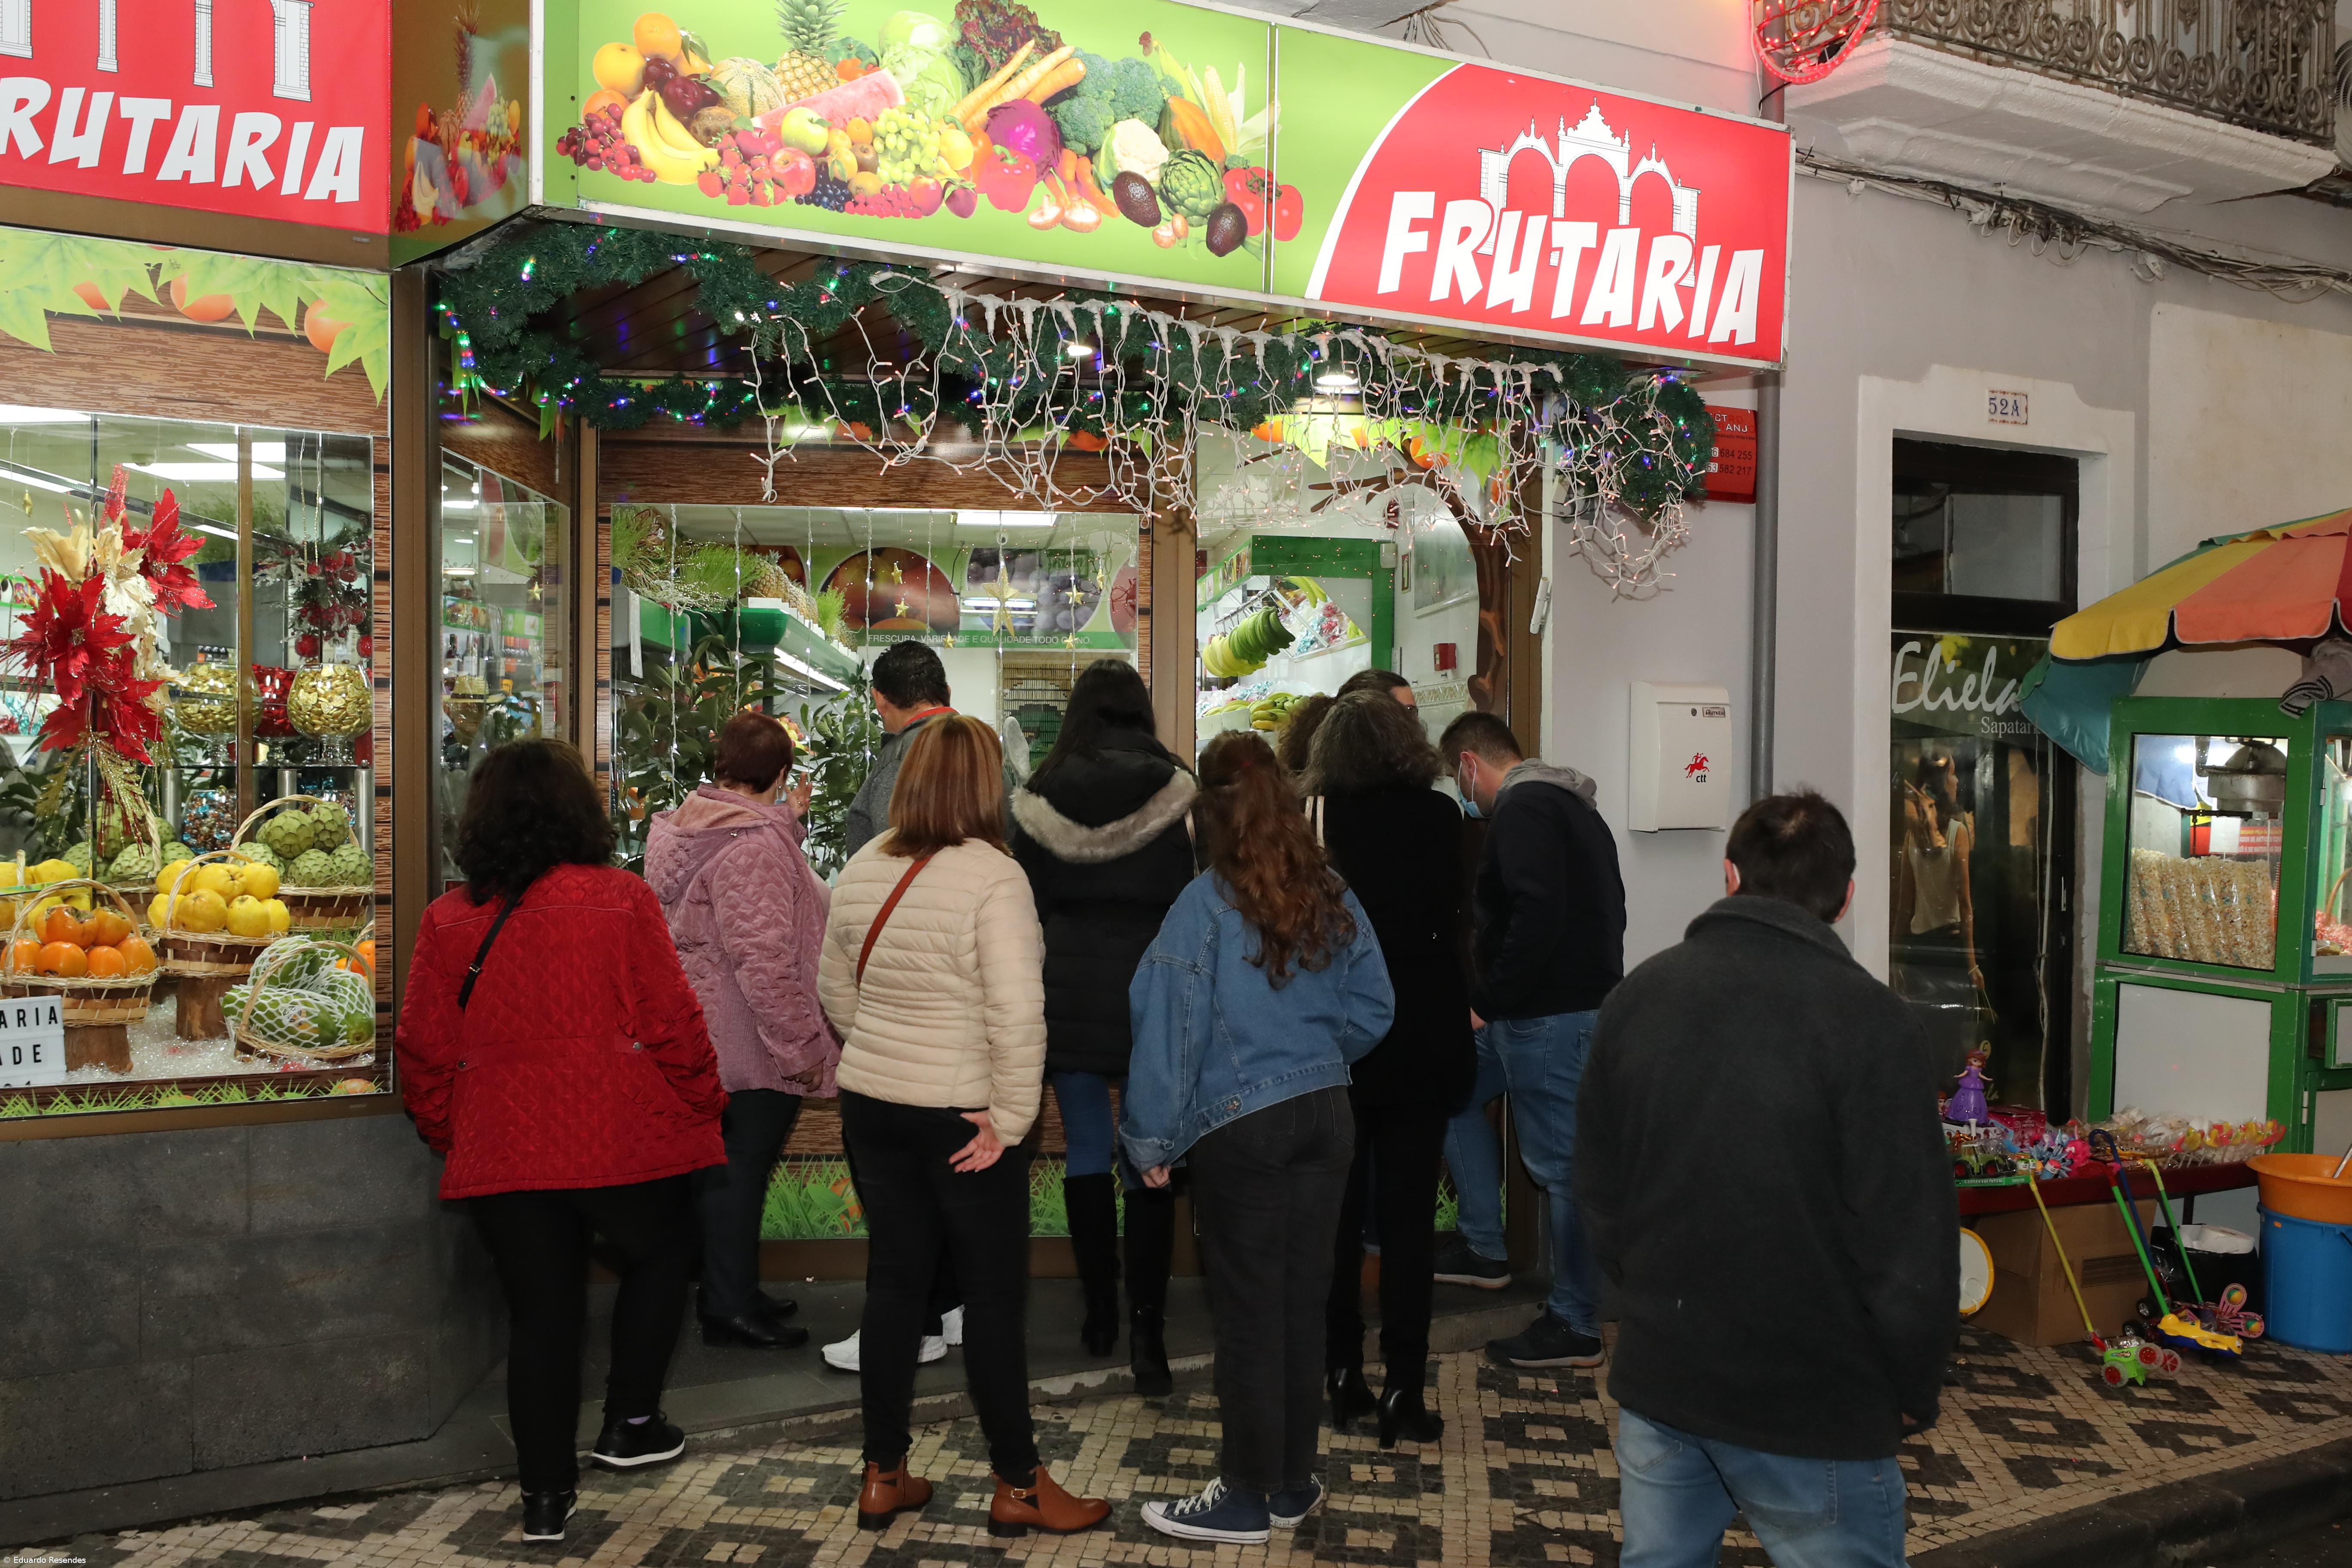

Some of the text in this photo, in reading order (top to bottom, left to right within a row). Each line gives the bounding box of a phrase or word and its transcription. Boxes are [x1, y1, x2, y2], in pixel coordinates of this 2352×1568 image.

[1376, 190, 1764, 346] FRUTARIA
[1988, 396, 2019, 416] 52A
[1720, 448, 1735, 458] 684
[1738, 450, 1752, 460] 255
[1706, 463, 1752, 475] 63 582 217
[921, 635, 970, 643] VARIEADE
[980, 635, 1031, 643] QUALIDADE
[1034, 636, 1059, 644] TODO
[1892, 641, 2020, 716] Eliela
[1696, 774, 1706, 783] ctt
[0, 1044, 42, 1066] DE
